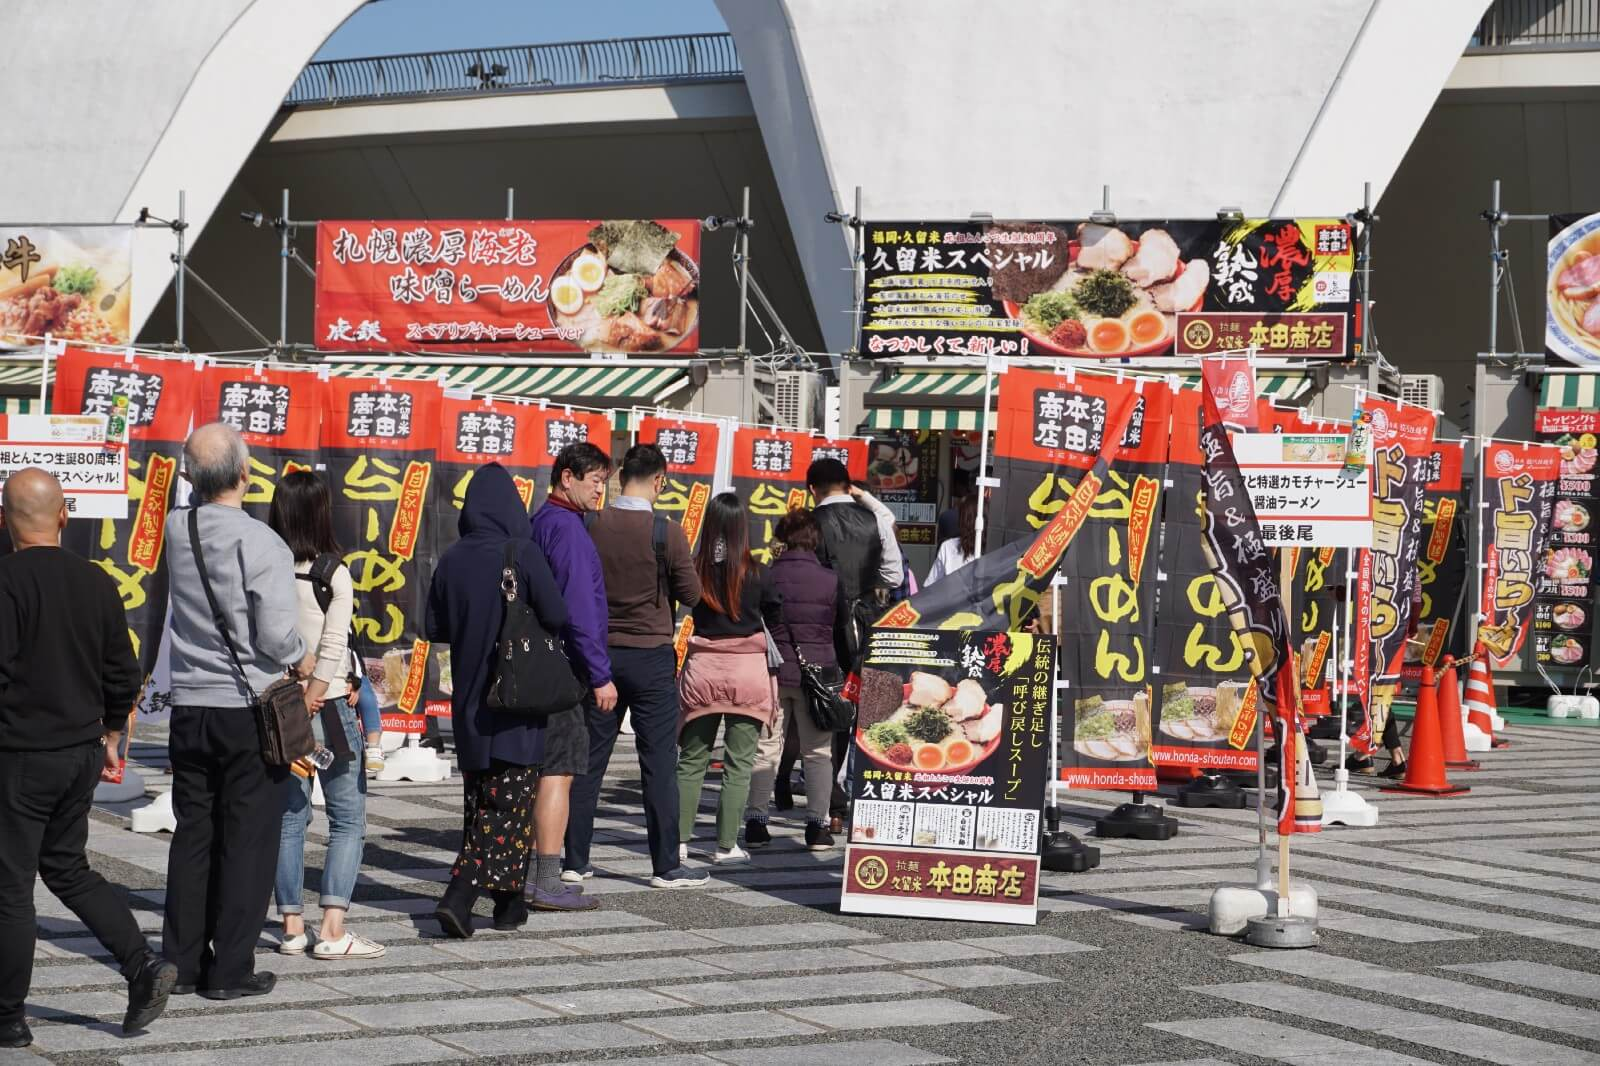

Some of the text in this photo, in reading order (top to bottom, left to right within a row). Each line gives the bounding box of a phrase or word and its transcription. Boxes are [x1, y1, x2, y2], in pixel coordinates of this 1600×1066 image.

[333, 228, 537, 266] 札幌濃厚海老
[870, 246, 1055, 273] 久留米スペシャル
[1260, 224, 1311, 301] 濃厚
[1211, 241, 1259, 305] 熟成
[1215, 336, 1246, 350] 久留米
[1248, 320, 1335, 350] 本田商店
[140, 375, 162, 422] 久留米
[247, 385, 273, 433] 本田
[272, 386, 289, 432] 久留米
[348, 392, 376, 437] 商店
[373, 394, 398, 437] 本田
[397, 393, 412, 435] 久留米
[456, 412, 482, 453] 商店
[481, 415, 503, 454] 本田
[501, 415, 515, 452] 久留米
[1034, 391, 1065, 448] 商店
[1063, 395, 1090, 452] 本田
[1088, 399, 1105, 450] 久留米
[1129, 396, 1144, 445] 久留米
[1254, 495, 1320, 509] 醤油ラーメン
[1262, 524, 1313, 541] 最後尾
[960, 644, 986, 678] 熟成
[984, 632, 1011, 673] 濃厚
[1030, 639, 1051, 748] 伝統の継ぎ足し
[1005, 676, 1031, 800] 「呼び戻しスープ」
[1152, 751, 1257, 766] www.honda-shouten.com
[862, 781, 994, 804] 久留米スペシャル
[891, 876, 923, 892] 久留米
[926, 860, 1025, 898] 本田商店
